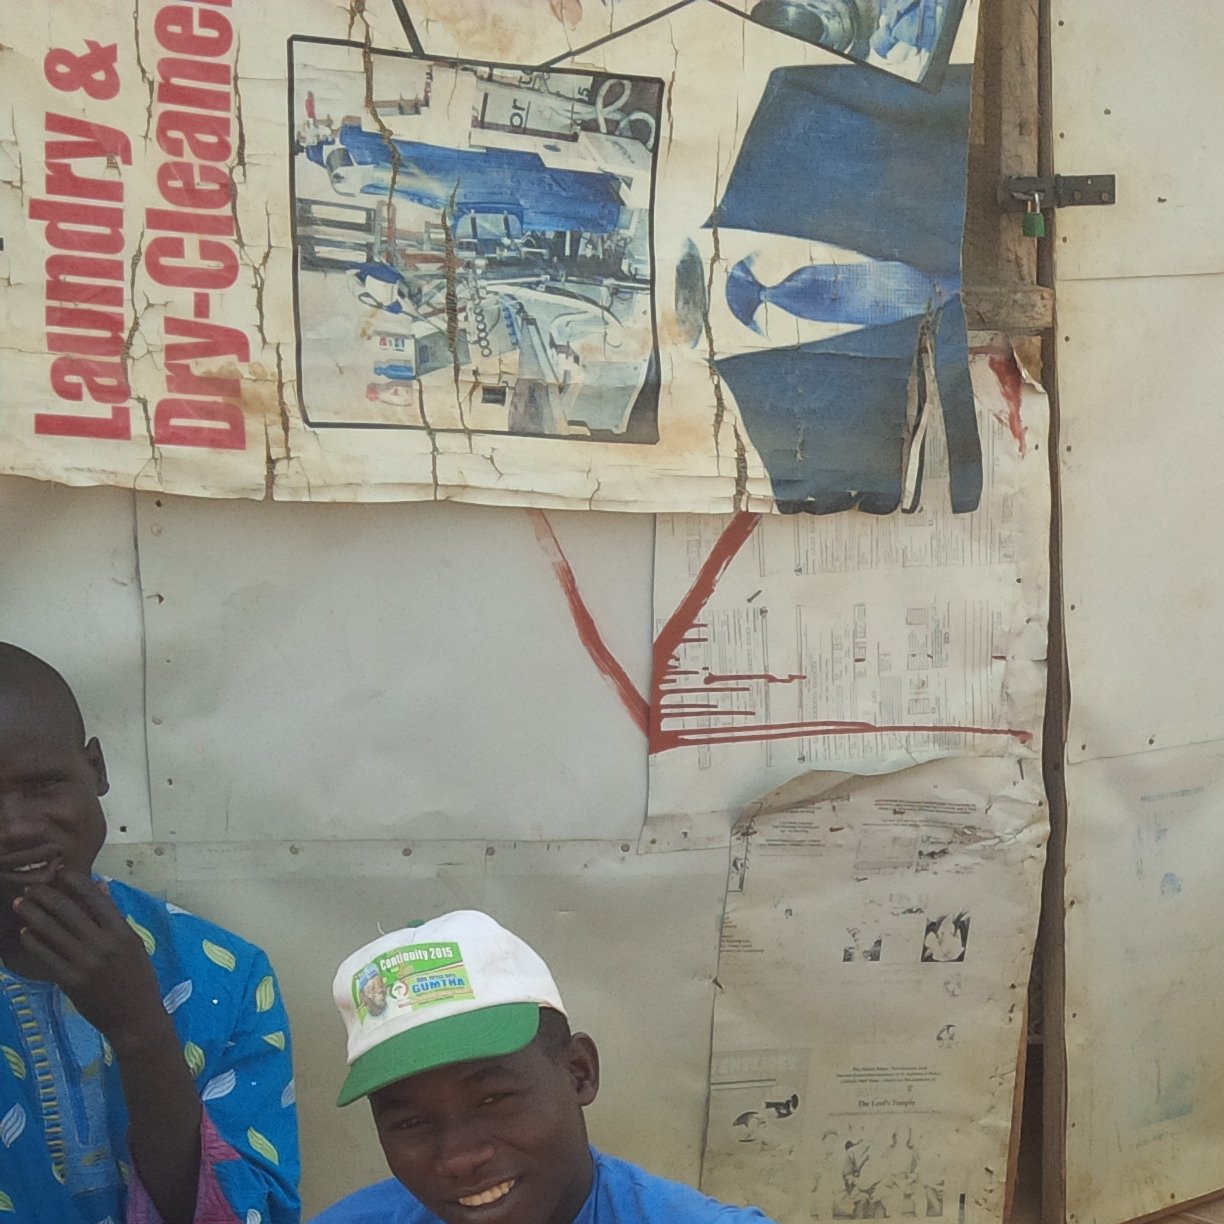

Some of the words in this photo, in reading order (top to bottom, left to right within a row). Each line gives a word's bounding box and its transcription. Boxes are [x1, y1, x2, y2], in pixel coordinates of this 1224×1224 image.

[43, 38, 120, 101] &
[29, 112, 133, 440] Laundry
[144, 0, 251, 451] Dry-Cleane
[380, 949, 428, 972] Continuity
[429, 947, 453, 959] 2015
